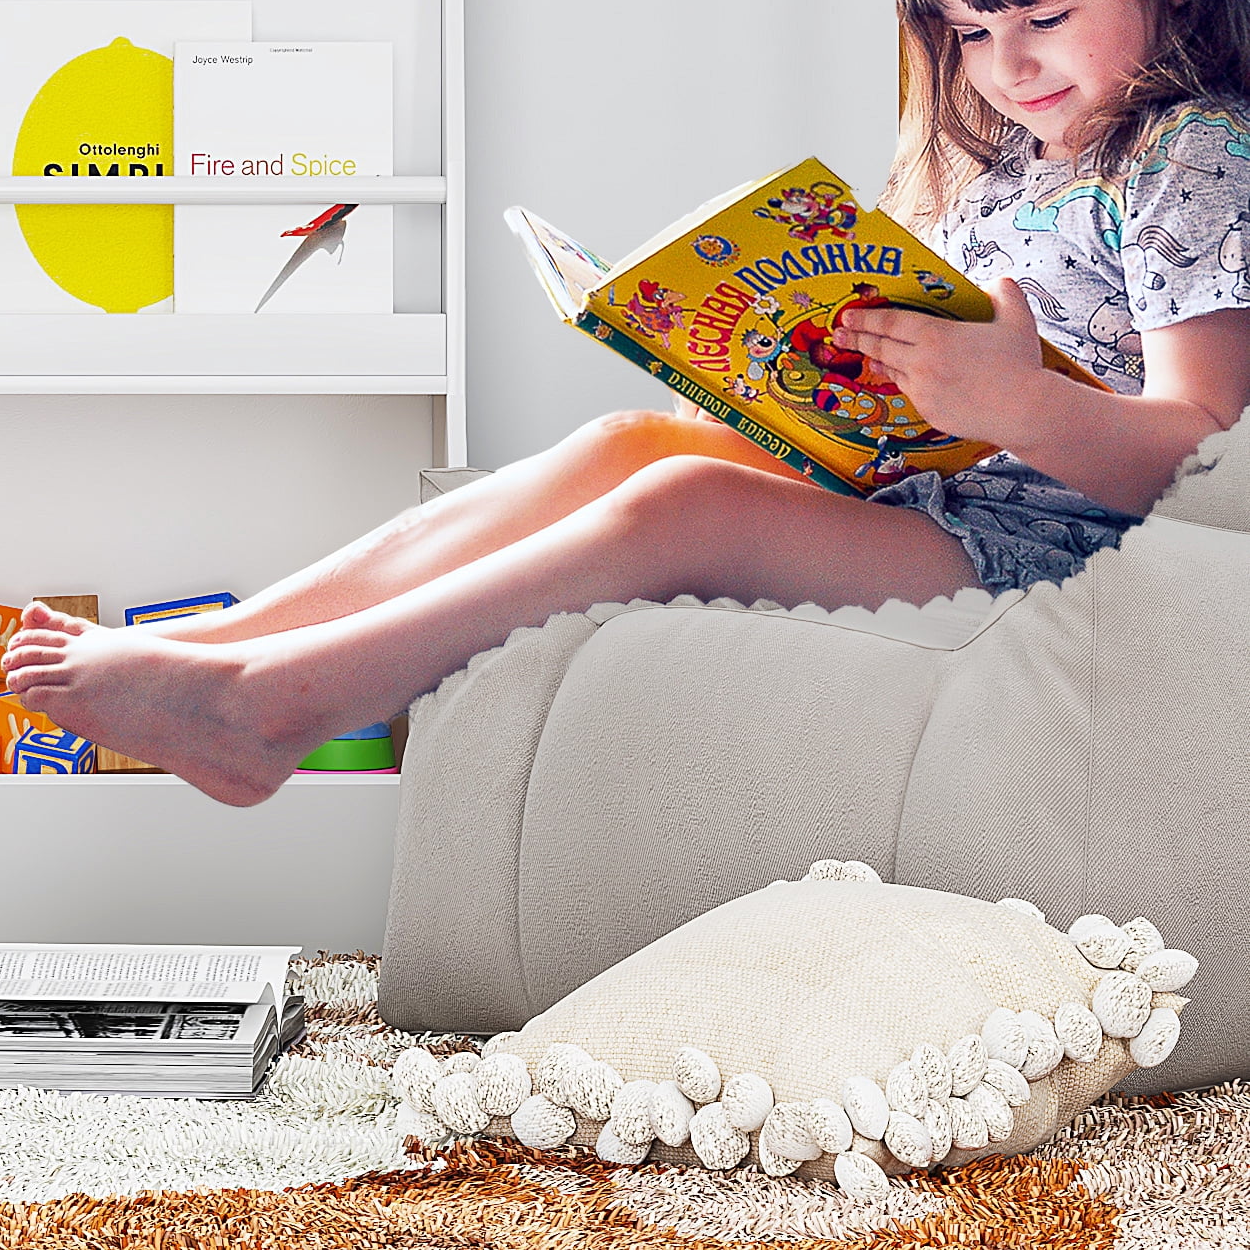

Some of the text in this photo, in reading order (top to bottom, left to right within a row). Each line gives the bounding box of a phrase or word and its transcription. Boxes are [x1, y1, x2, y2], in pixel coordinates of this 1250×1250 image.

[192, 55, 253, 66] Joyce Westrip
[79, 143, 159, 159] Ottolenghi
[191, 152, 356, 177] Fire and Spice
